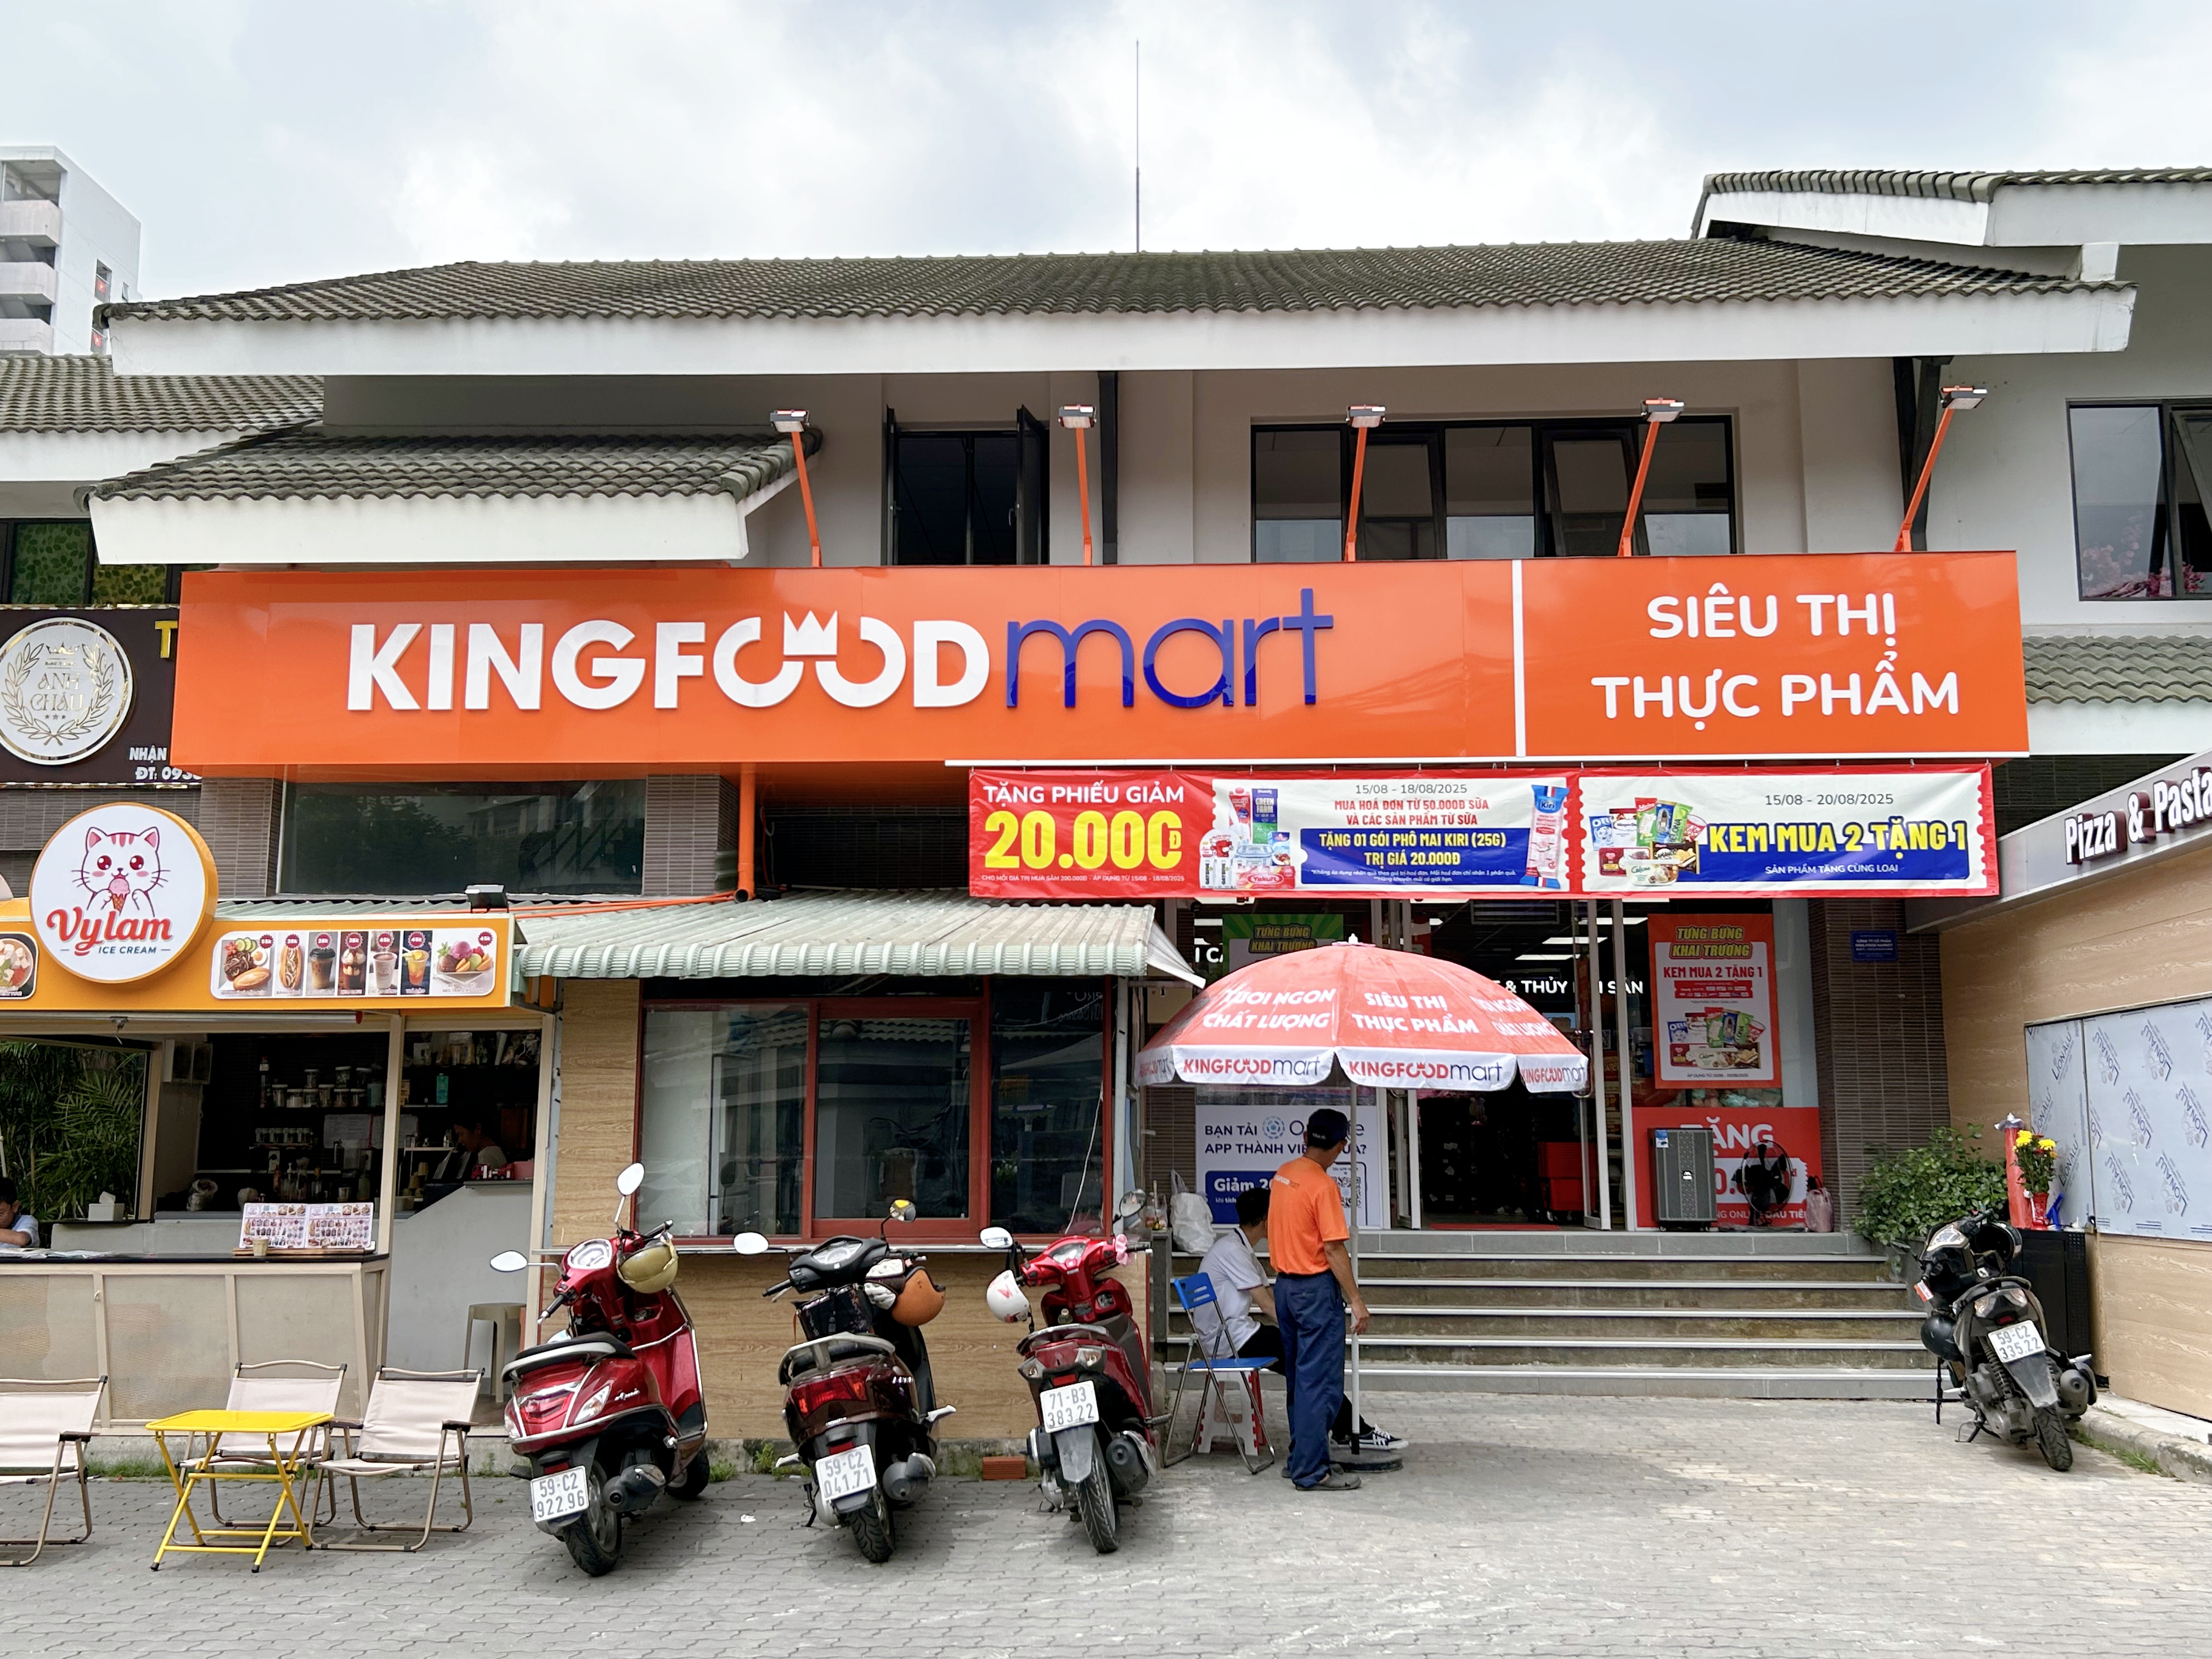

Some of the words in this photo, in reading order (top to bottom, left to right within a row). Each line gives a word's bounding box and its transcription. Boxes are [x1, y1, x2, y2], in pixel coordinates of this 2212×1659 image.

[1648, 582, 1777, 640] SIÊU
[1796, 591, 1897, 648] THỊ
[38, 673, 81, 690] ANH
[1591, 670, 1759, 731] THỰC
[1781, 650, 1960, 719] PHẨM
[31, 691, 83, 711] CHÂU
[129, 744, 167, 763] NHẬN
[135, 766, 158, 780] ĐT:
[983, 781, 1045, 807] TẶNG
[1052, 780, 1119, 803] PHIẾU
[1126, 781, 1184, 803] GIẢM
[1356, 785, 1388, 794] 15/08
[1401, 784, 1468, 794] 18/08/2025
[1334, 800, 1356, 810] MUA
[1359, 798, 1379, 810] HOÁ
[1383, 800, 1403, 810] ĐƠN
[1407, 798, 1420, 810] TỪ
[1423, 799, 1465, 810] 50.000Đ
[1469, 797, 1489, 810] SỮA
[1540, 800, 1556, 810] Kiri
[1764, 794, 1803, 805] 15/08
[1817, 793, 1893, 805] 20/08/2025
[1256, 805, 1274, 814] FARM
[1346, 812, 1359, 825] VÀ
[1363, 812, 1382, 825] CÁC
[1385, 812, 1406, 825] SẢN
[1409, 811, 1438, 825] PHẨM
[1441, 812, 1454, 825] TỪ
[1458, 812, 1478, 825] SỮA
[2064, 810, 2118, 865] Pizza
[2128, 792, 2144, 843] &
[2153, 768, 2212, 832] Pasta
[1319, 831, 1351, 850] TẶNG
[1354, 833, 1367, 847] 01
[1370, 831, 1390, 847] GÓI
[1393, 831, 1417, 847] PHÔ
[1420, 833, 1441, 847] MAI
[1444, 833, 1469, 847] KIRI
[1471, 832, 1506, 848] (25G)
[1708, 823, 1769, 853] KEM
[1775, 823, 1837, 853] MUA
[1844, 822, 1864, 852] 2
[1869, 816, 1948, 860] TẶNG
[1954, 821, 1967, 851] 1
[1364, 852, 1384, 868] TRỊ
[1387, 849, 1407, 865] GIÁ
[1410, 852, 1461, 866] 20.000Đ
[1765, 864, 1786, 874] SẢN
[1787, 863, 1816, 874] PHẨM
[1818, 864, 1845, 875] TẶNG
[1847, 862, 1875, 873] CÙNG
[1876, 864, 1899, 874] LOẠI
[47, 906, 173, 952] Vylam
[1255, 924, 1280, 937] TƯNG
[1282, 924, 1310, 936] BỪNG
[1677, 926, 1708, 939] TƯNG
[1709, 926, 1743, 939] BỪNG
[1251, 940, 1274, 951] KHAI
[1276, 939, 1314, 951] TRƯƠNG
[1672, 944, 1700, 957] KHAI
[1703, 943, 1751, 957] TRƯƠNG
[1663, 967, 1686, 978] KEM
[1689, 967, 1713, 978] MUA
[1716, 967, 1723, 978] 2
[1725, 964, 1754, 981] TẶNG
[1757, 967, 1763, 978] 1
[1505, 980, 1517, 994] &
[1521, 976, 1568, 994] THỦY
[1273, 988, 1336, 1005] NGON
[1364, 991, 1408, 1008] SIÊU
[1410, 995, 1448, 1011] THỊ
[1203, 1009, 1258, 1028] CHẤT
[1257, 1012, 1331, 1031] LƯỢNG
[1351, 1013, 1409, 1033] THỰC
[1410, 1013, 1480, 1034] PHẨM
[1205, 1125, 1233, 1138] BẠN
[1236, 1122, 1257, 1136] TẢI
[1680, 1116, 1774, 1156] ẶNG
[1205, 1143, 1232, 1154] APP
[1235, 1141, 1283, 1154] THÀNH
[1214, 1177, 1255, 1192] Giảm
[1788, 1209, 1807, 1218] TIÊ
[1999, 1337, 2041, 1360] 335.22
[1047, 1403, 1094, 1428] 383.22
[823, 1466, 871, 1497] 041.71
[536, 1489, 585, 1518] 922.96
